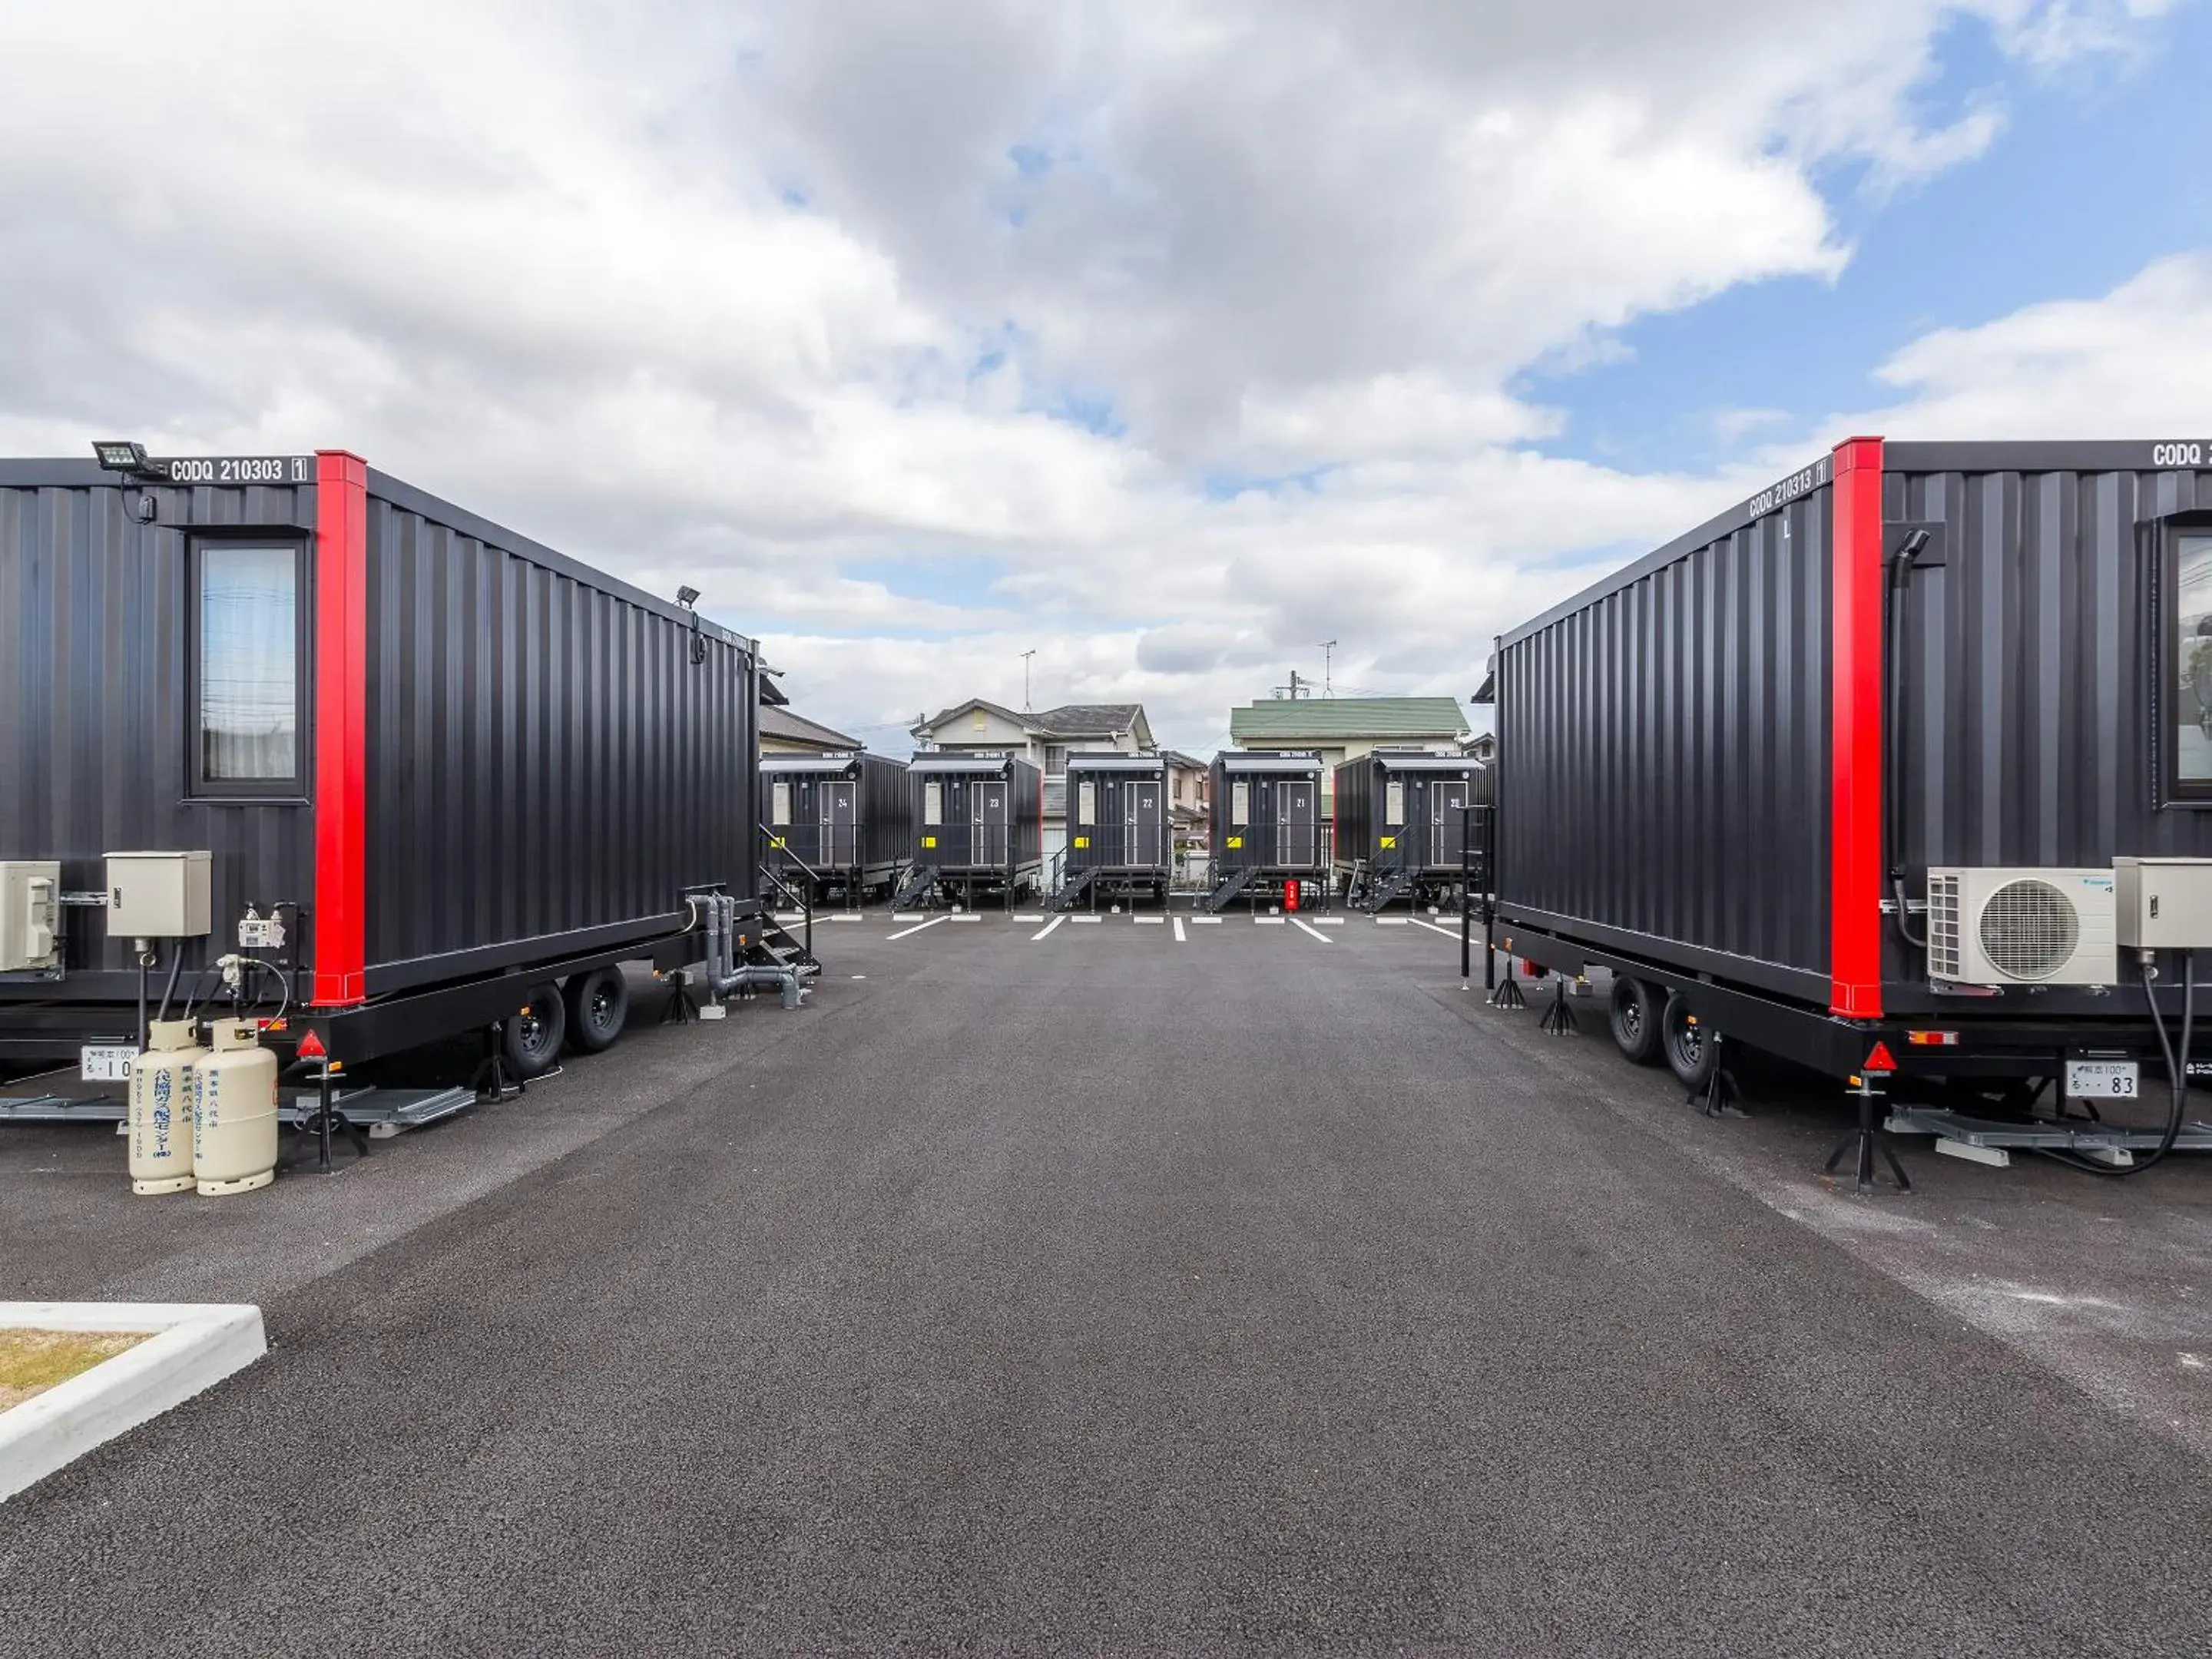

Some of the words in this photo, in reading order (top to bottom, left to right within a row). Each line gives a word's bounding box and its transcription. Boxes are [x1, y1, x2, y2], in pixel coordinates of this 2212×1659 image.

[2154, 443, 2200, 465] CODQ
[172, 461, 214, 481] CODQ
[220, 460, 282, 480] 210303
[1750, 491, 1772, 516] CODQ
[1775, 469, 1811, 504] 210313
[1784, 520, 1790, 538] L
[2112, 1078, 2133, 1094] 83
